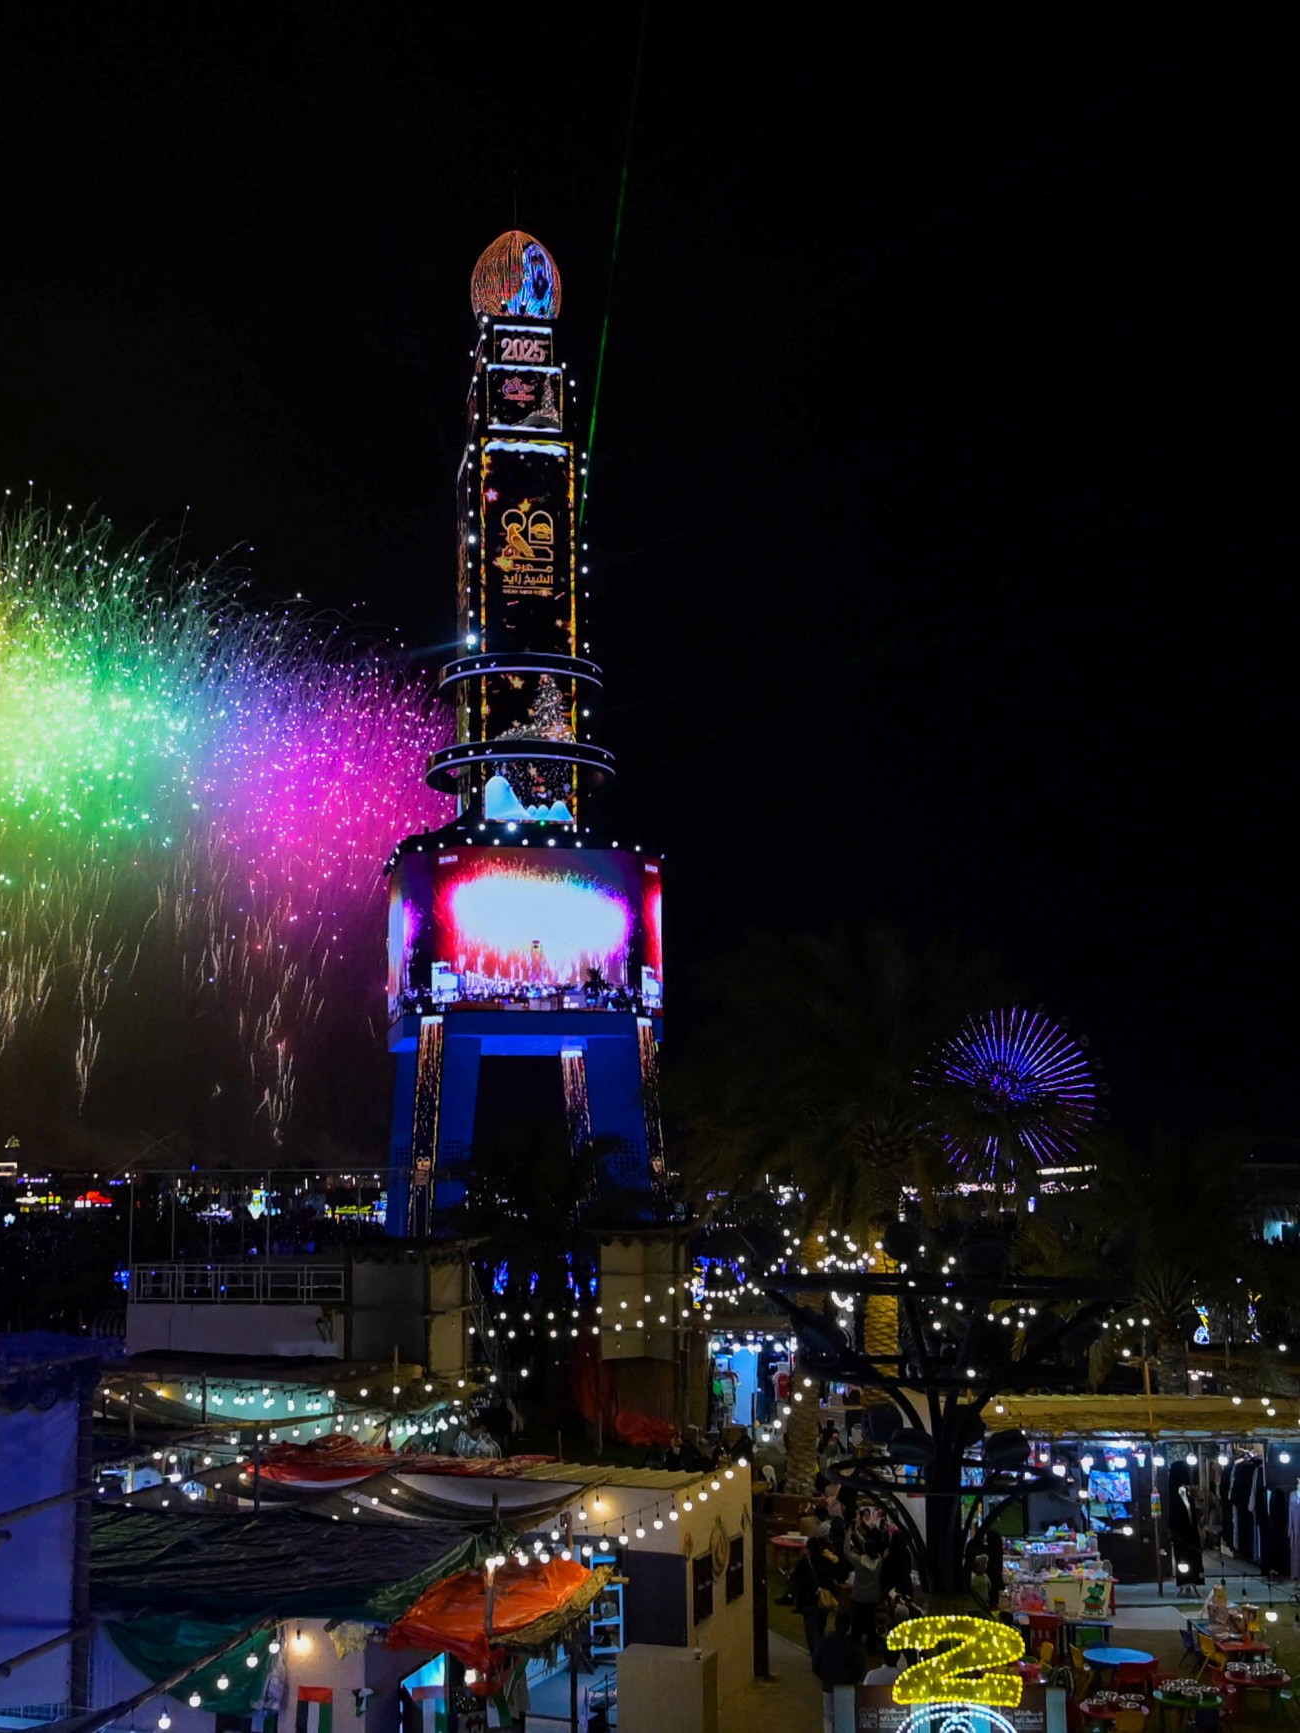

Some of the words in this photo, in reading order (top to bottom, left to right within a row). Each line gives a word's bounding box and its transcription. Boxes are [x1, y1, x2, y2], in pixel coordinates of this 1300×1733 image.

[501, 338, 546, 362] 2025
[504, 563, 553, 573] مهرج
[503, 573, 522, 585] زايد
[523, 573, 553, 585] الشيخ
[886, 1615, 1025, 1707] 2
